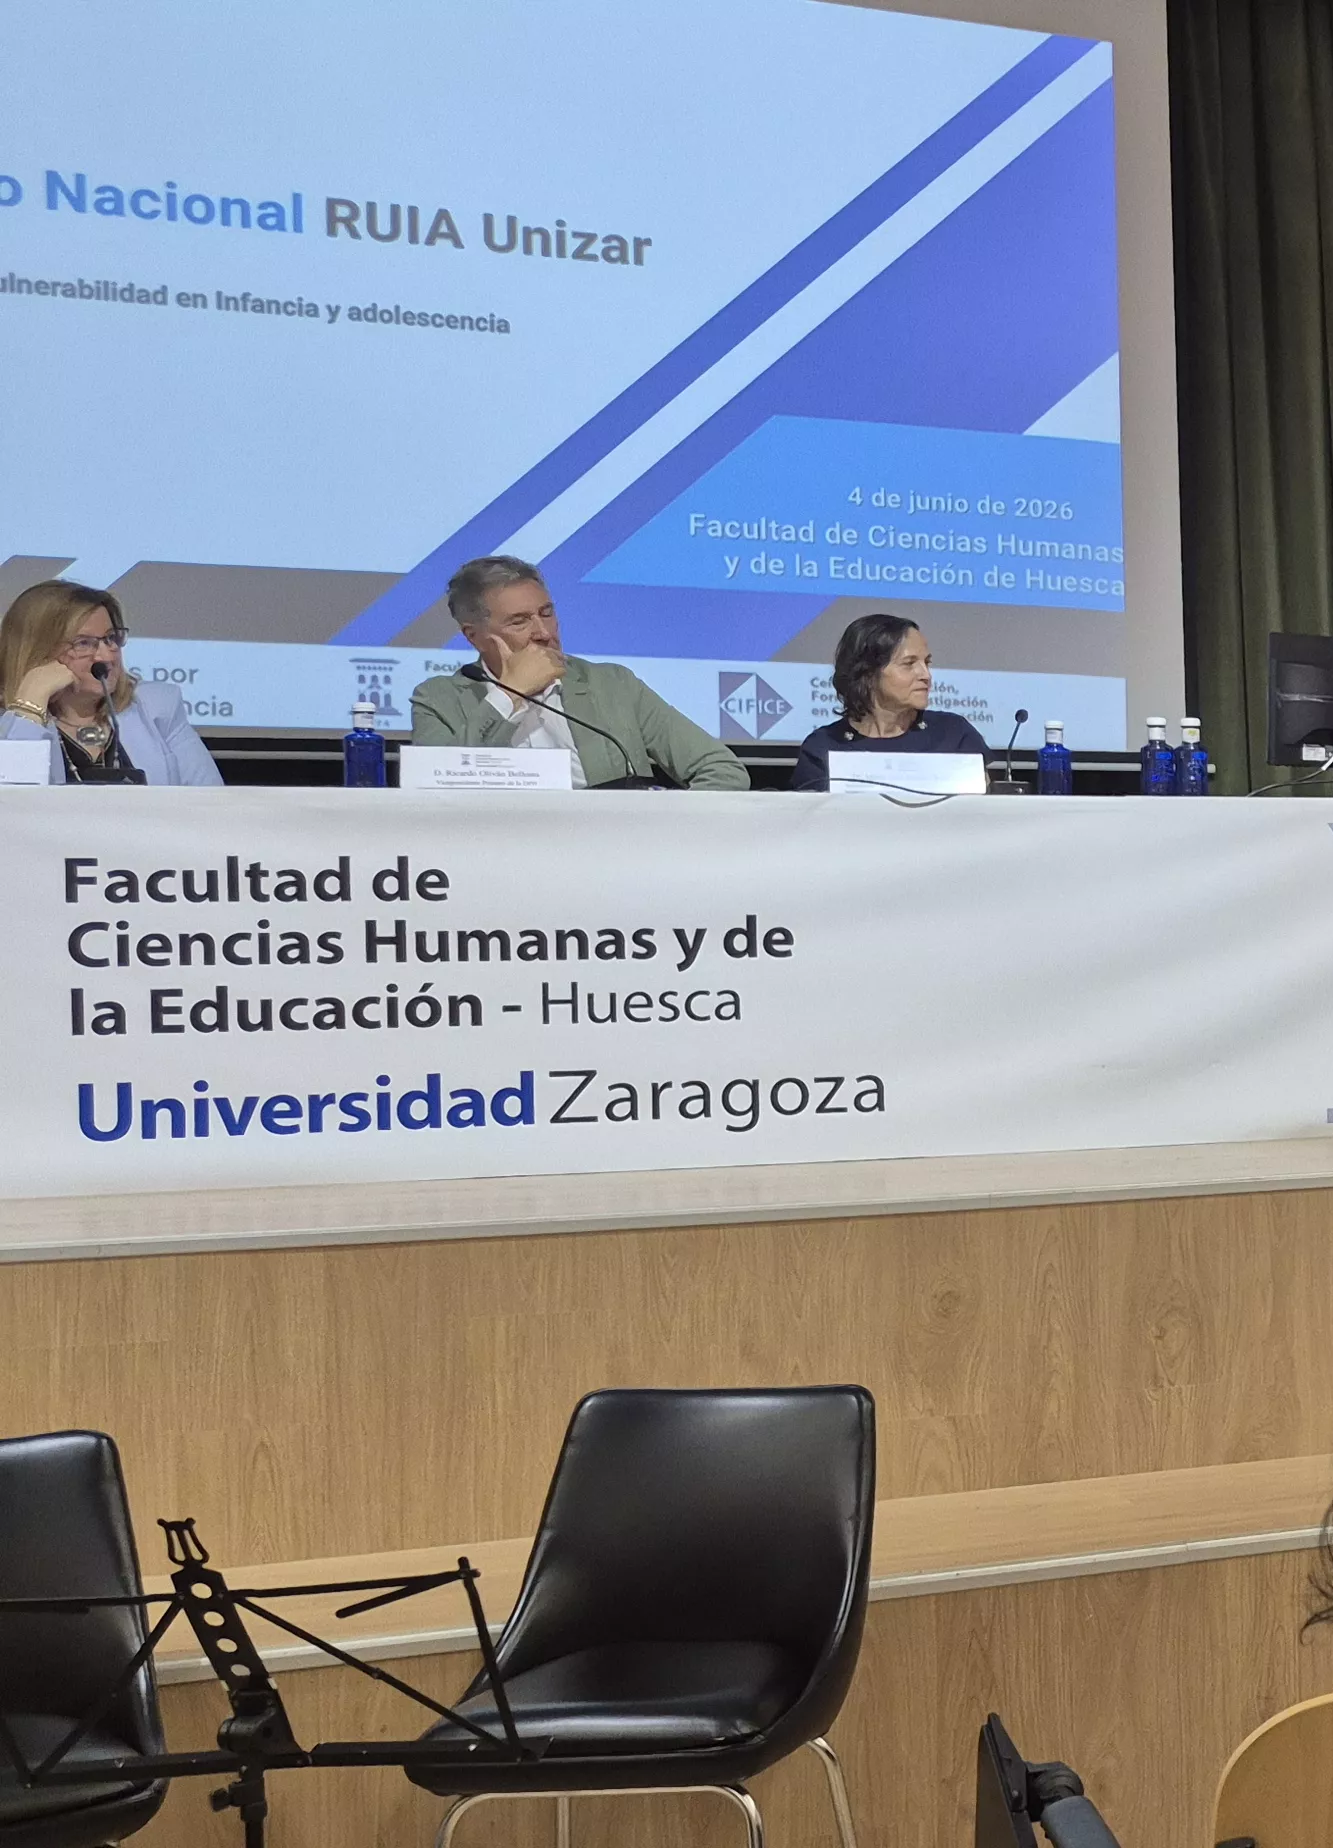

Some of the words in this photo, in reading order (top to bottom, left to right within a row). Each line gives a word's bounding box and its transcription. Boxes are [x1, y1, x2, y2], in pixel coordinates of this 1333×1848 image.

[45, 169, 304, 234] Nacional
[325, 196, 465, 250] RUIA
[482, 212, 653, 267] Unizar
[175, 290, 208, 310] en
[216, 290, 320, 319] Infancia
[327, 304, 342, 324] y
[347, 304, 511, 335] adolescencia
[848, 486, 864, 507] 4
[872, 487, 902, 508] de
[906, 490, 970, 515] junio
[976, 494, 1006, 516] de
[1013, 497, 1074, 521] 2026
[688, 513, 816, 544] Facultad
[824, 522, 859, 546] de
[867, 525, 988, 555] Ciencias
[996, 533, 1125, 564] Humanas
[723, 555, 741, 580] y
[750, 551, 785, 576] de
[795, 553, 819, 578] la
[828, 555, 974, 587] Educación
[983, 565, 1017, 589] de
[1025, 568, 1125, 597] Huesca
[152, 667, 200, 685] por
[181, 695, 234, 717] ncia
[724, 696, 786, 715] CIFICE
[63, 854, 352, 904] Facultad
[371, 854, 451, 903] de
[67, 918, 345, 968] Ciencias
[364, 918, 658, 964] Humanas
[673, 926, 708, 972] y
[722, 914, 795, 959] de
[70, 987, 128, 1036] la
[149, 982, 483, 1035] Educación
[501, 1003, 523, 1013] -
[541, 981, 742, 1025] Huesca
[77, 1069, 536, 1143] Universidad
[548, 1068, 886, 1133] Zaragoza
